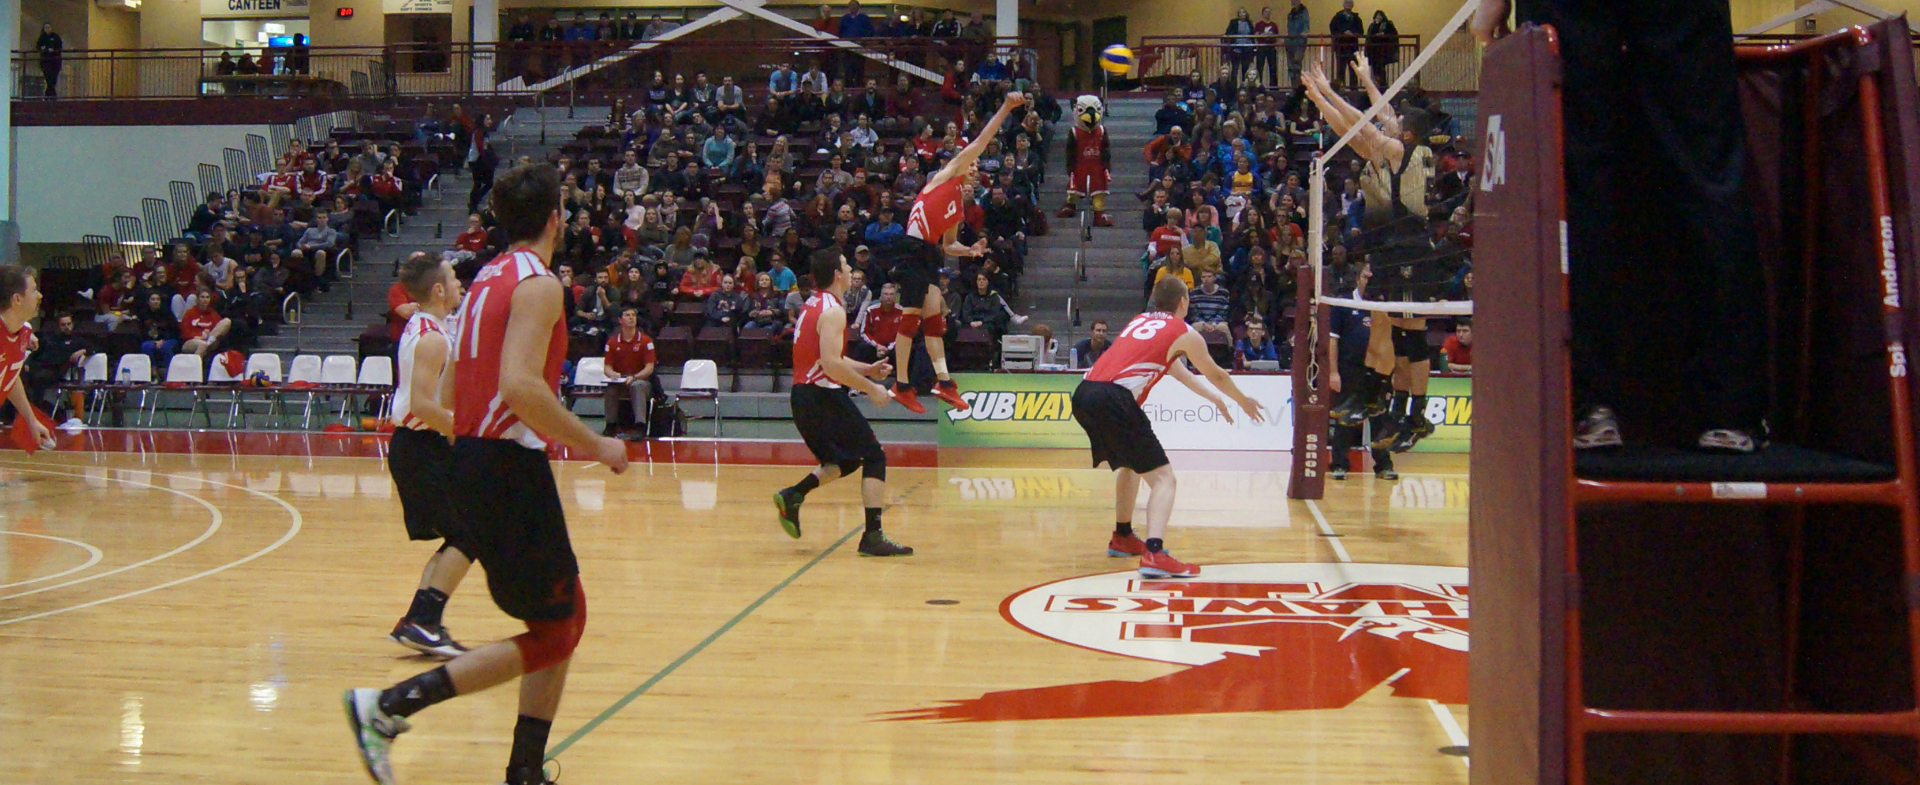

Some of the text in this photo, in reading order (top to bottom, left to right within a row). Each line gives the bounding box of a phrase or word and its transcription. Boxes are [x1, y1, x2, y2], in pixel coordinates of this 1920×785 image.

[228, 0, 281, 10] CANTEEN
[1879, 215, 1900, 308] Anderson
[1119, 317, 1167, 340] 18
